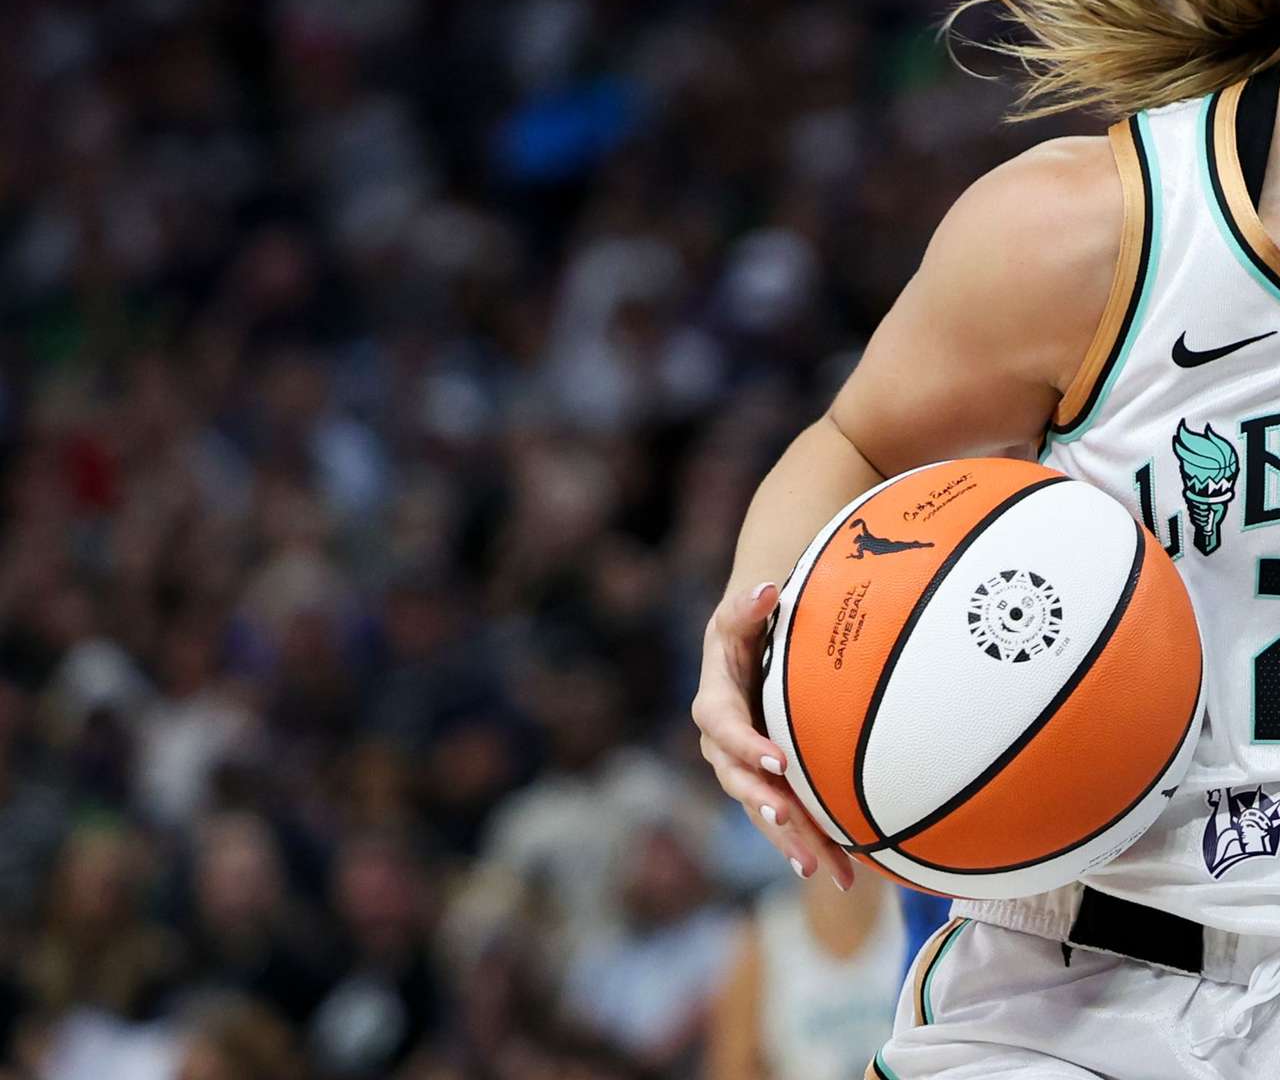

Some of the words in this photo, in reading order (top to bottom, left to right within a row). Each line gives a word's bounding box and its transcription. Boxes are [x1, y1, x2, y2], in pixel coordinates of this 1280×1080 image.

[827, 586, 857, 657] OFFICIAL
[834, 622, 854, 670] GAME
[848, 580, 872, 620] BALL
